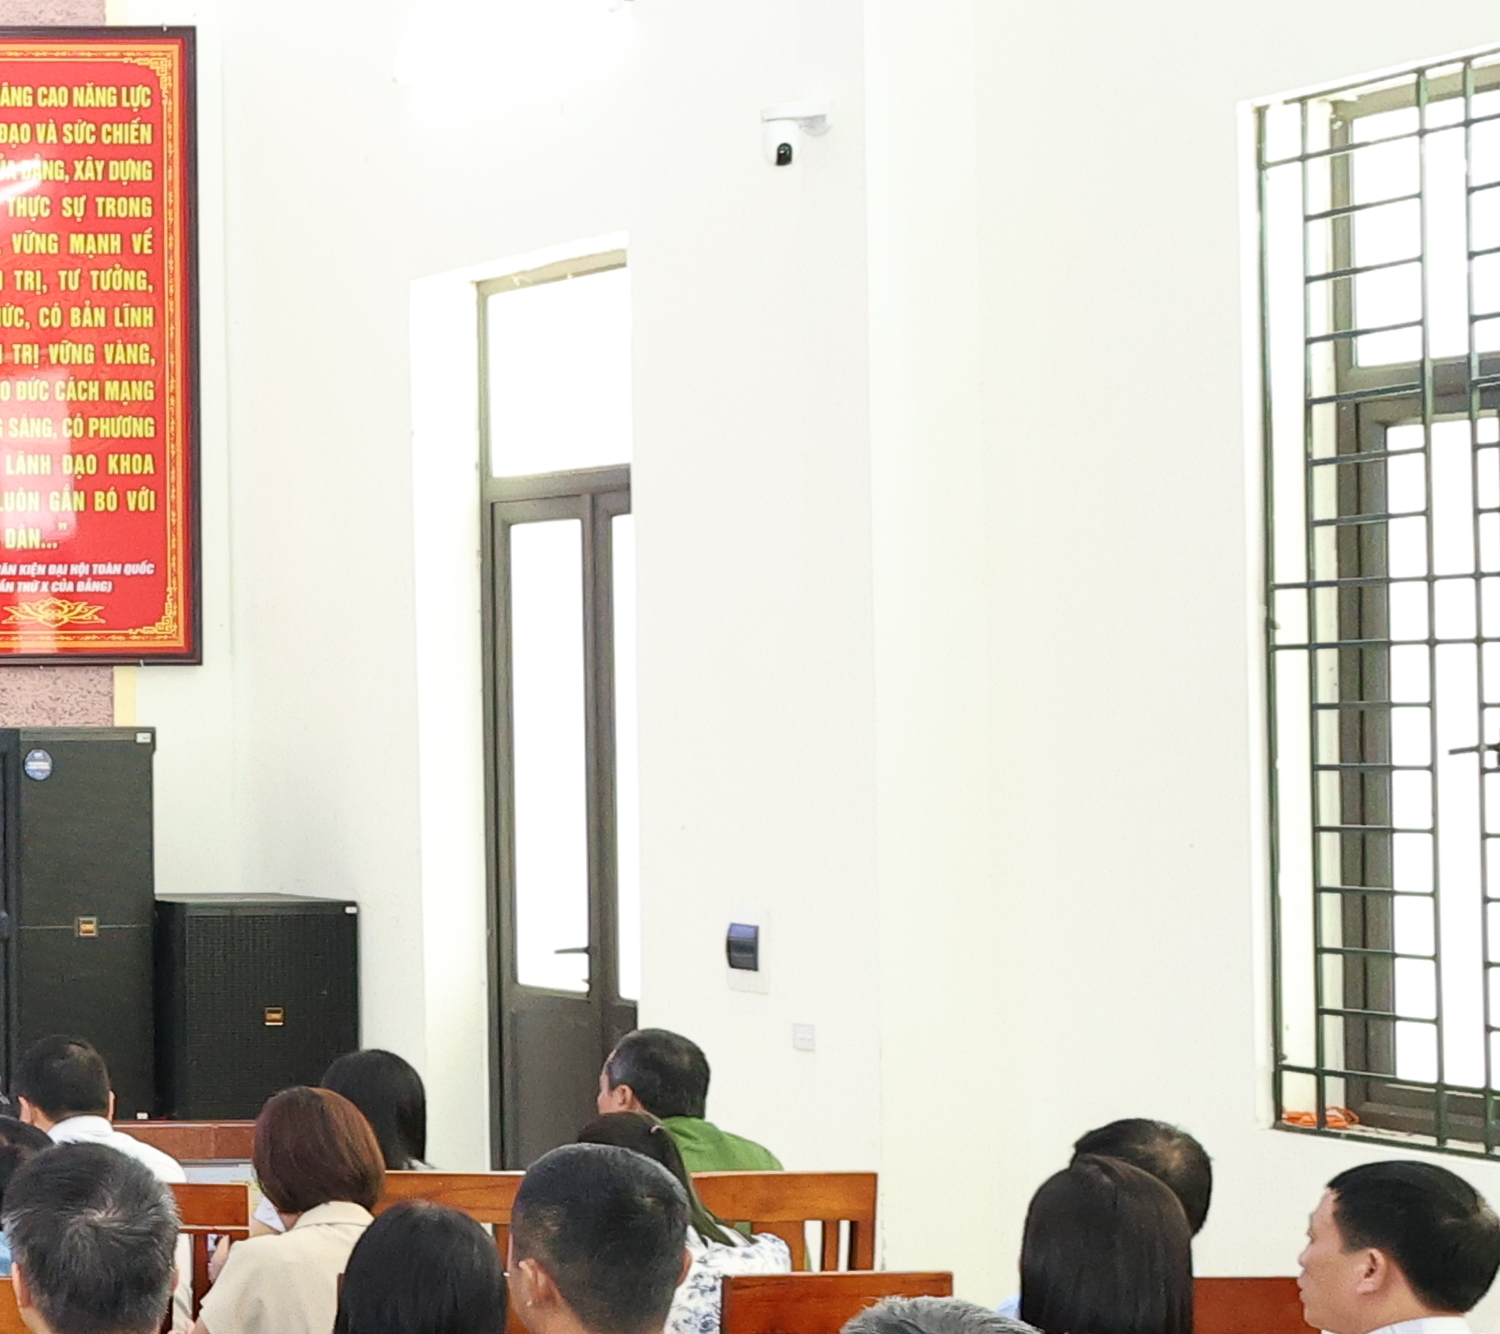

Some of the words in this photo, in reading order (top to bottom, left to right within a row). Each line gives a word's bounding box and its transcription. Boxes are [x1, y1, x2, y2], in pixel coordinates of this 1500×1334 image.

[37, 86, 69, 108] CAO
[72, 82, 118, 108] NĂNG
[121, 84, 152, 112] LỰC
[35, 118, 58, 144] VÀ
[62, 119, 96, 145] SỨC
[101, 117, 152, 145] CHIẾN
[13, 269, 48, 295] TRỊ,
[57, 268, 81, 291] TƯ
[89, 263, 153, 293] TƯỞNG,
[39, 302, 62, 328] CÓ
[70, 300, 106, 328] BẢN
[114, 303, 154, 328] LĨNH
